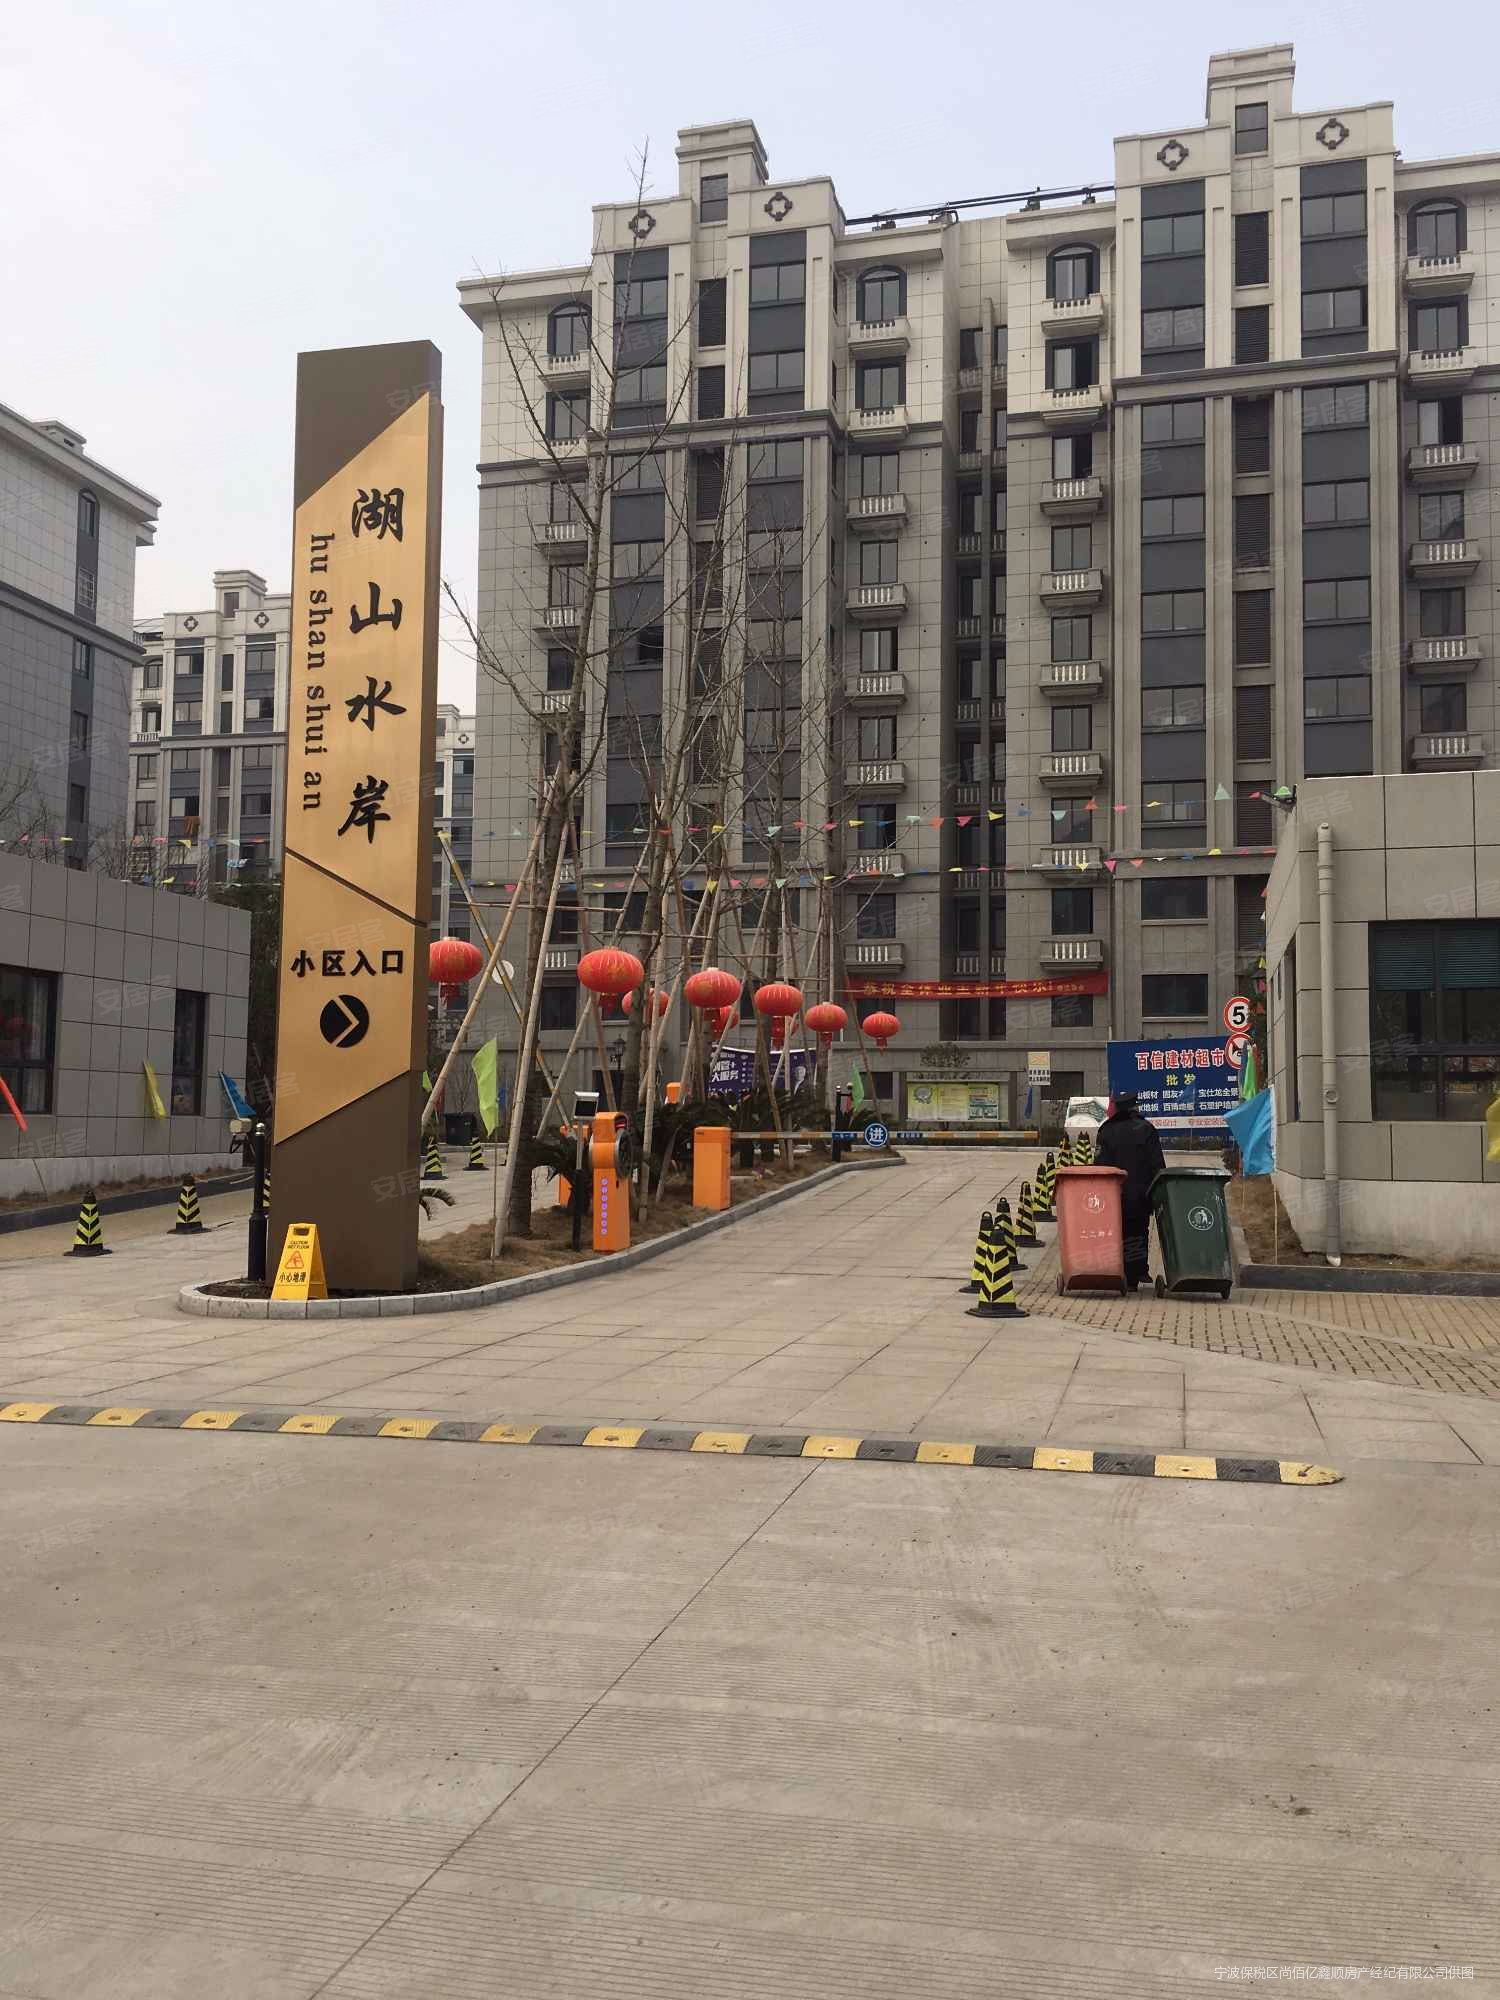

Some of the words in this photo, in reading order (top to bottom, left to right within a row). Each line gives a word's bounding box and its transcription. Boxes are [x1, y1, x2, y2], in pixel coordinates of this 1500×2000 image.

[311, 533, 335, 572] hu
[307, 591, 333, 670] shan
[337, 487, 407, 844] 湖山水岸
[305, 686, 331, 755] shui
[303, 771, 322, 810] an
[290, 950, 404, 978] 小区入口
[1232, 1006, 1245, 1025] 5
[1135, 1048, 1225, 1070] 百信建材超市
[869, 1128, 884, 1142] 进
